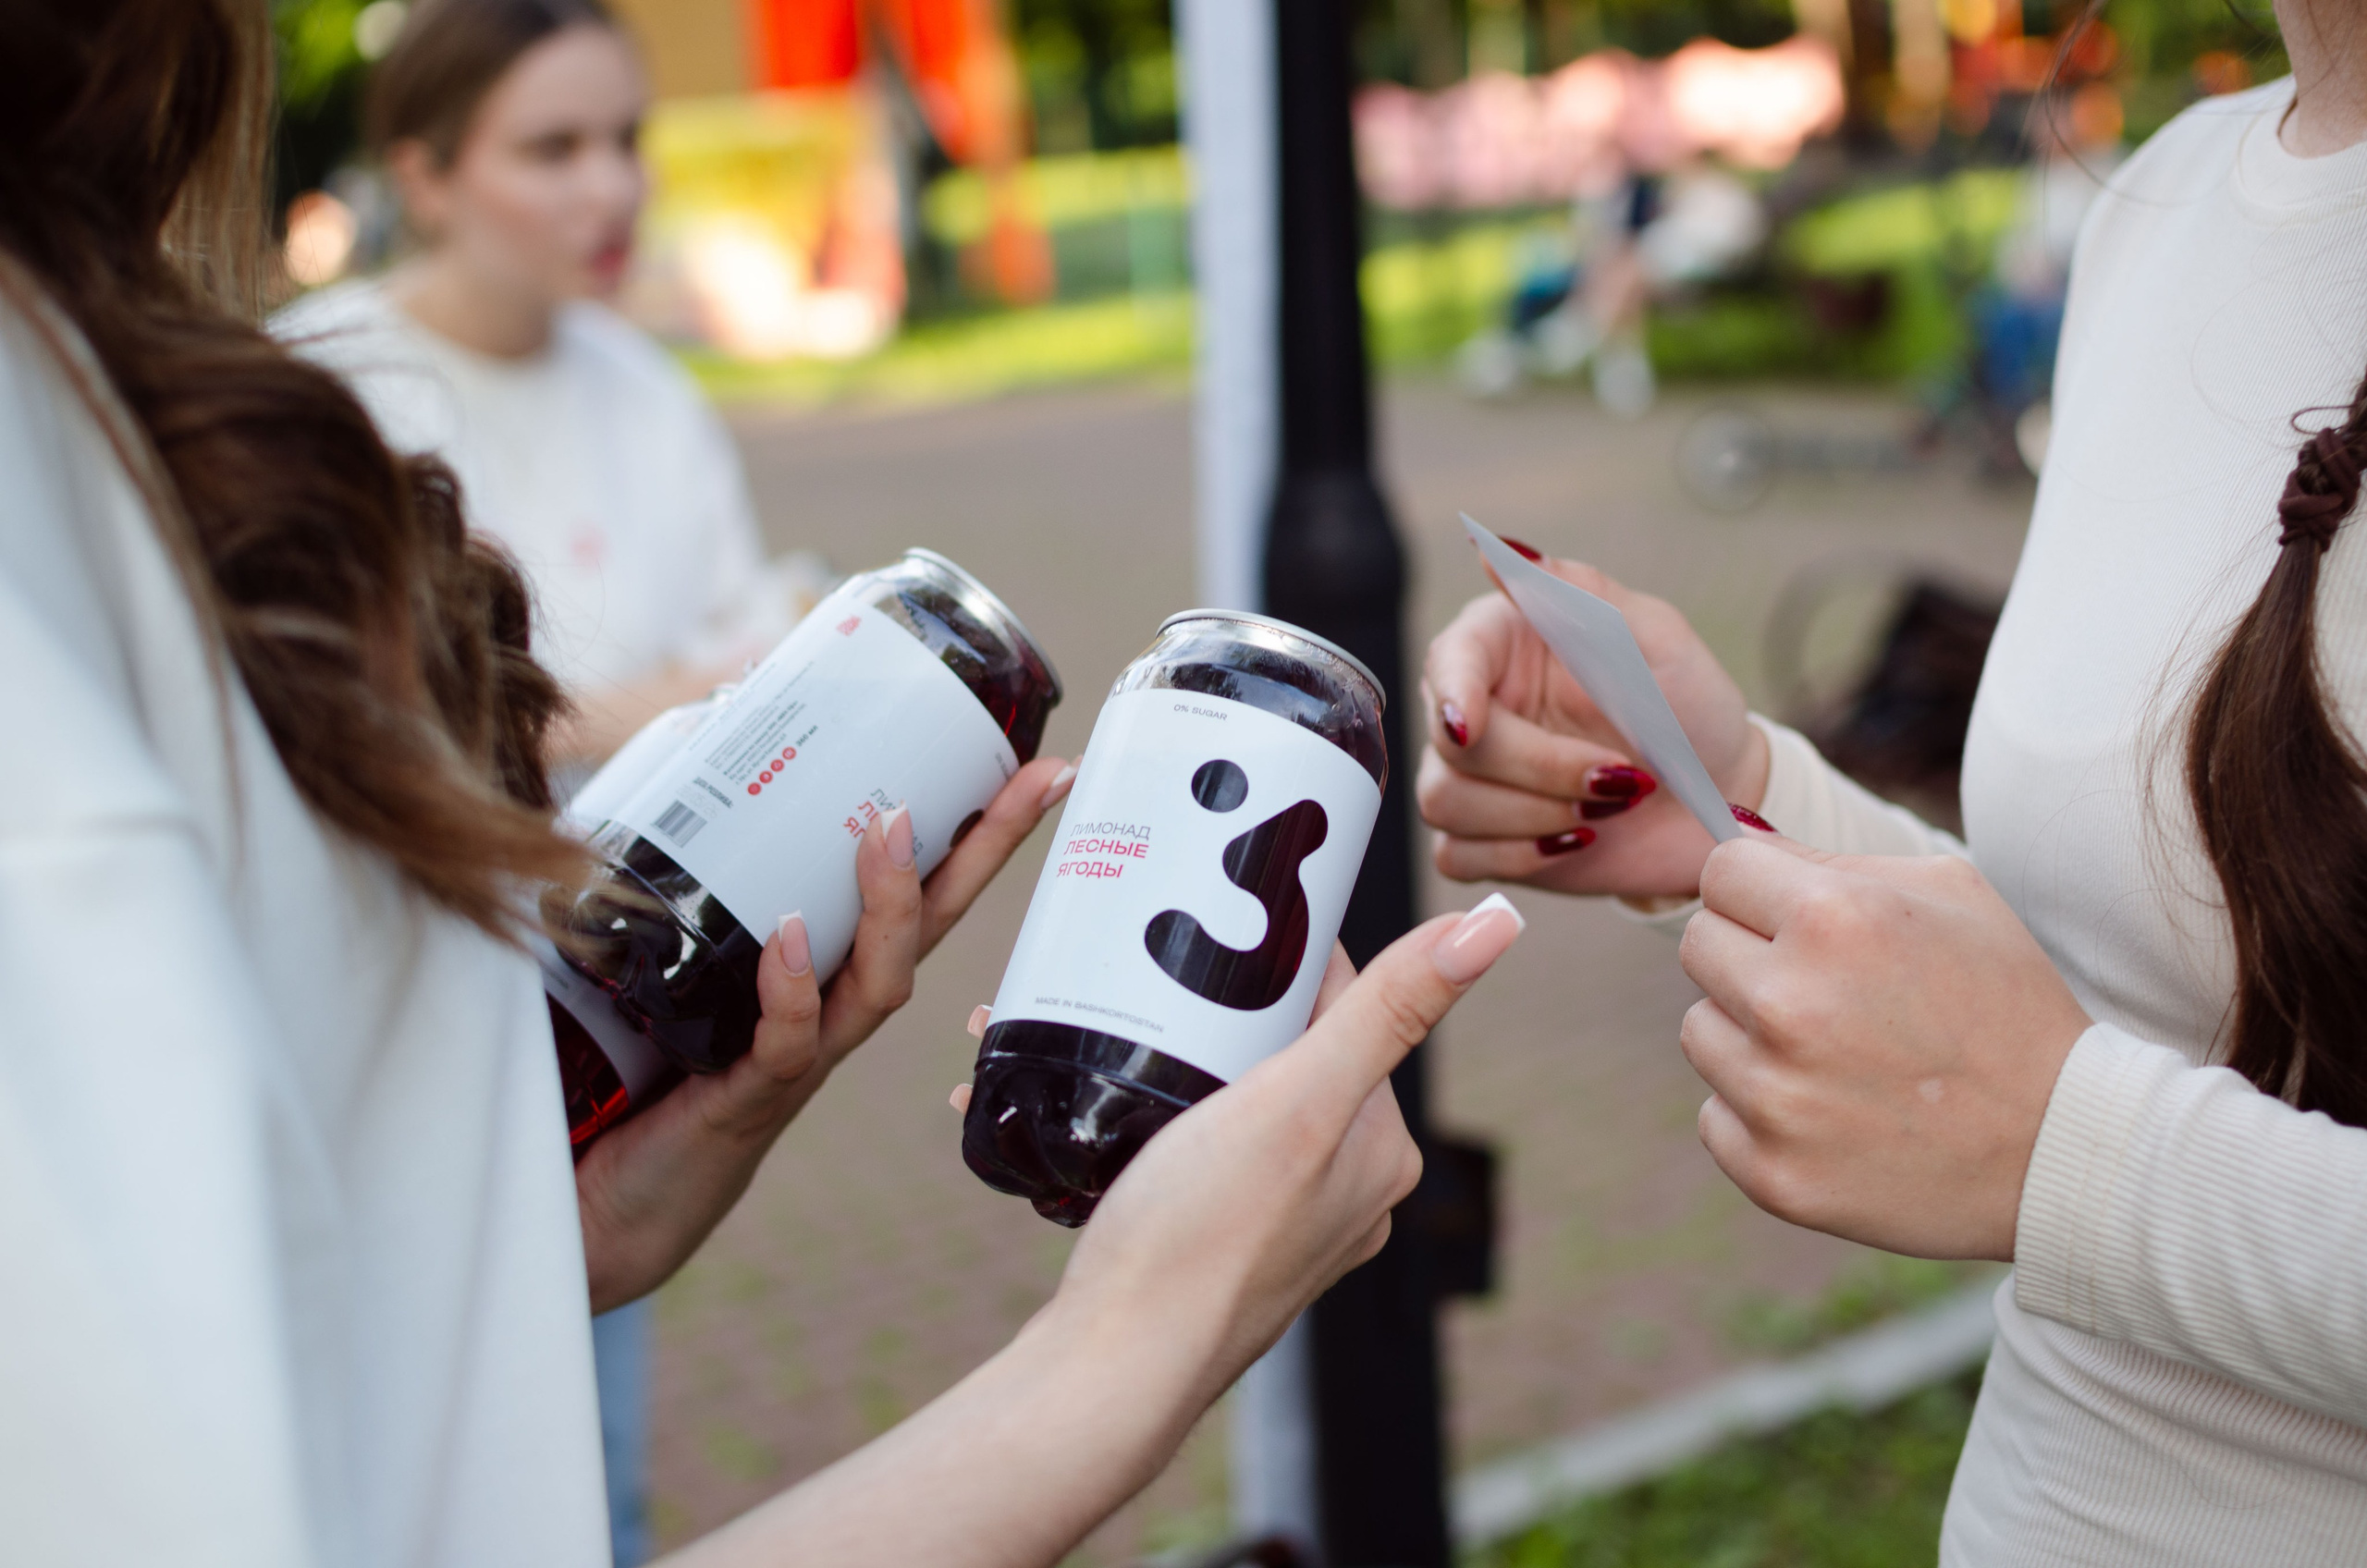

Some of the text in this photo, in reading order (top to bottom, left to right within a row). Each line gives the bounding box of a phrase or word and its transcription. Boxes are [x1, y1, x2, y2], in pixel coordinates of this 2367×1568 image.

[1173, 704, 1228, 721] 0% SUGAR
[1070, 822, 1151, 841] ЛИМОНАД
[1063, 839, 1149, 859] ЛЕСНЫЕ
[1057, 861, 1124, 878] ЯГОДЫ
[1035, 997, 1164, 1034] MADE IN BASHKORTOSTAN
